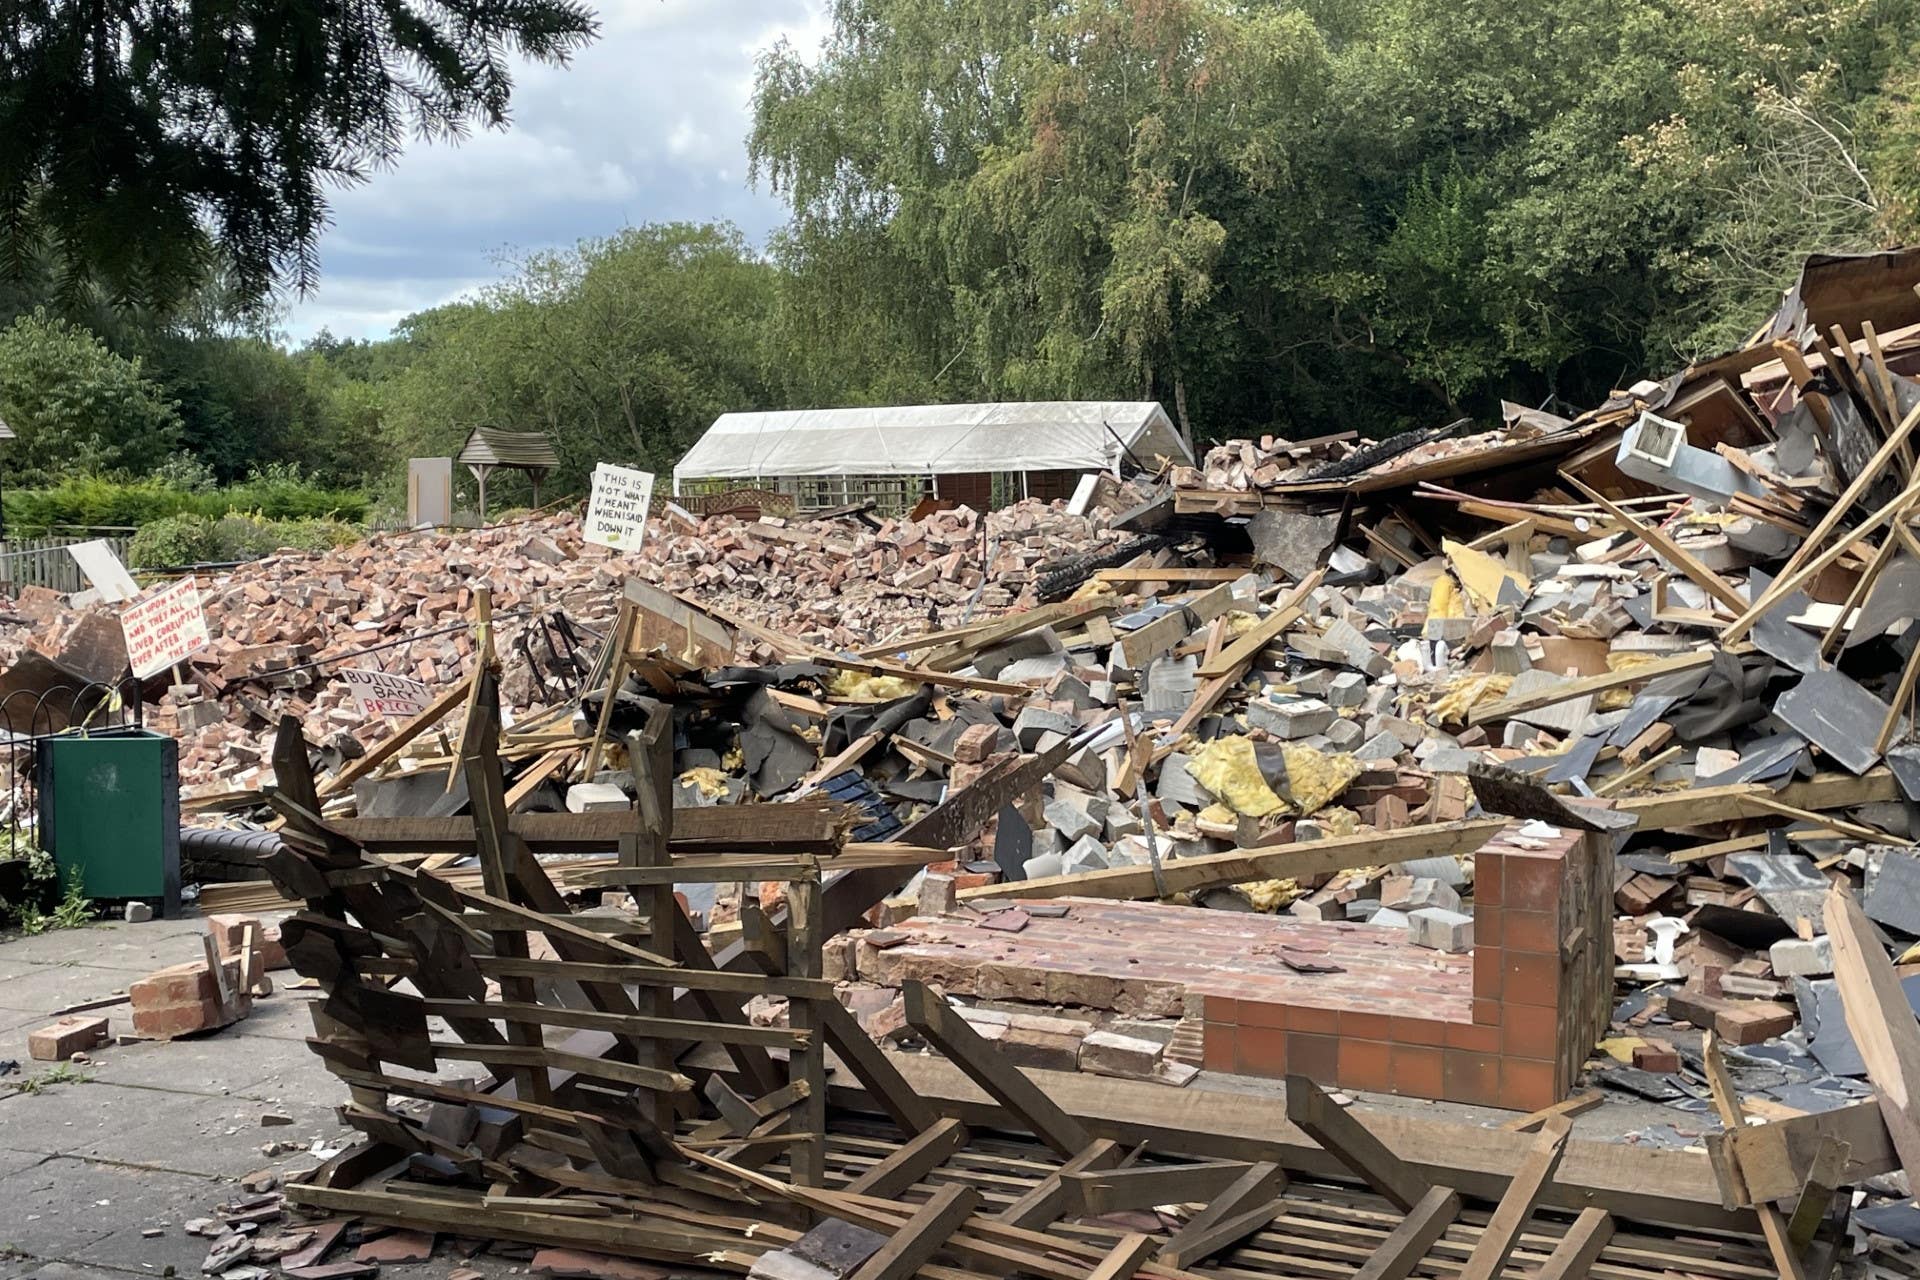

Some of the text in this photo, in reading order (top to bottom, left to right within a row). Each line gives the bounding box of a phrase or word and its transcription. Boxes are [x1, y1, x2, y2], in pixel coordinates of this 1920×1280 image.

[604, 473, 641, 490] THIS IS
[599, 486, 645, 503] NOT WHAT
[604, 499, 636, 510] MEANT
[595, 507, 621, 519] WHEN
[626, 514, 643, 523] SAID
[597, 521, 635, 536] DOWN IT
[123, 581, 195, 625] ONCE UPON A TIME
[129, 603, 185, 639] AND THEY ALL
[129, 604, 200, 654] LIVED CORRUPTLY
[132, 650, 152, 668] EVER
[168, 645, 184, 659] THE
[346, 671, 427, 697] BUILD IT
[372, 686, 416, 701] BACK
[363, 698, 411, 712] BRICK
